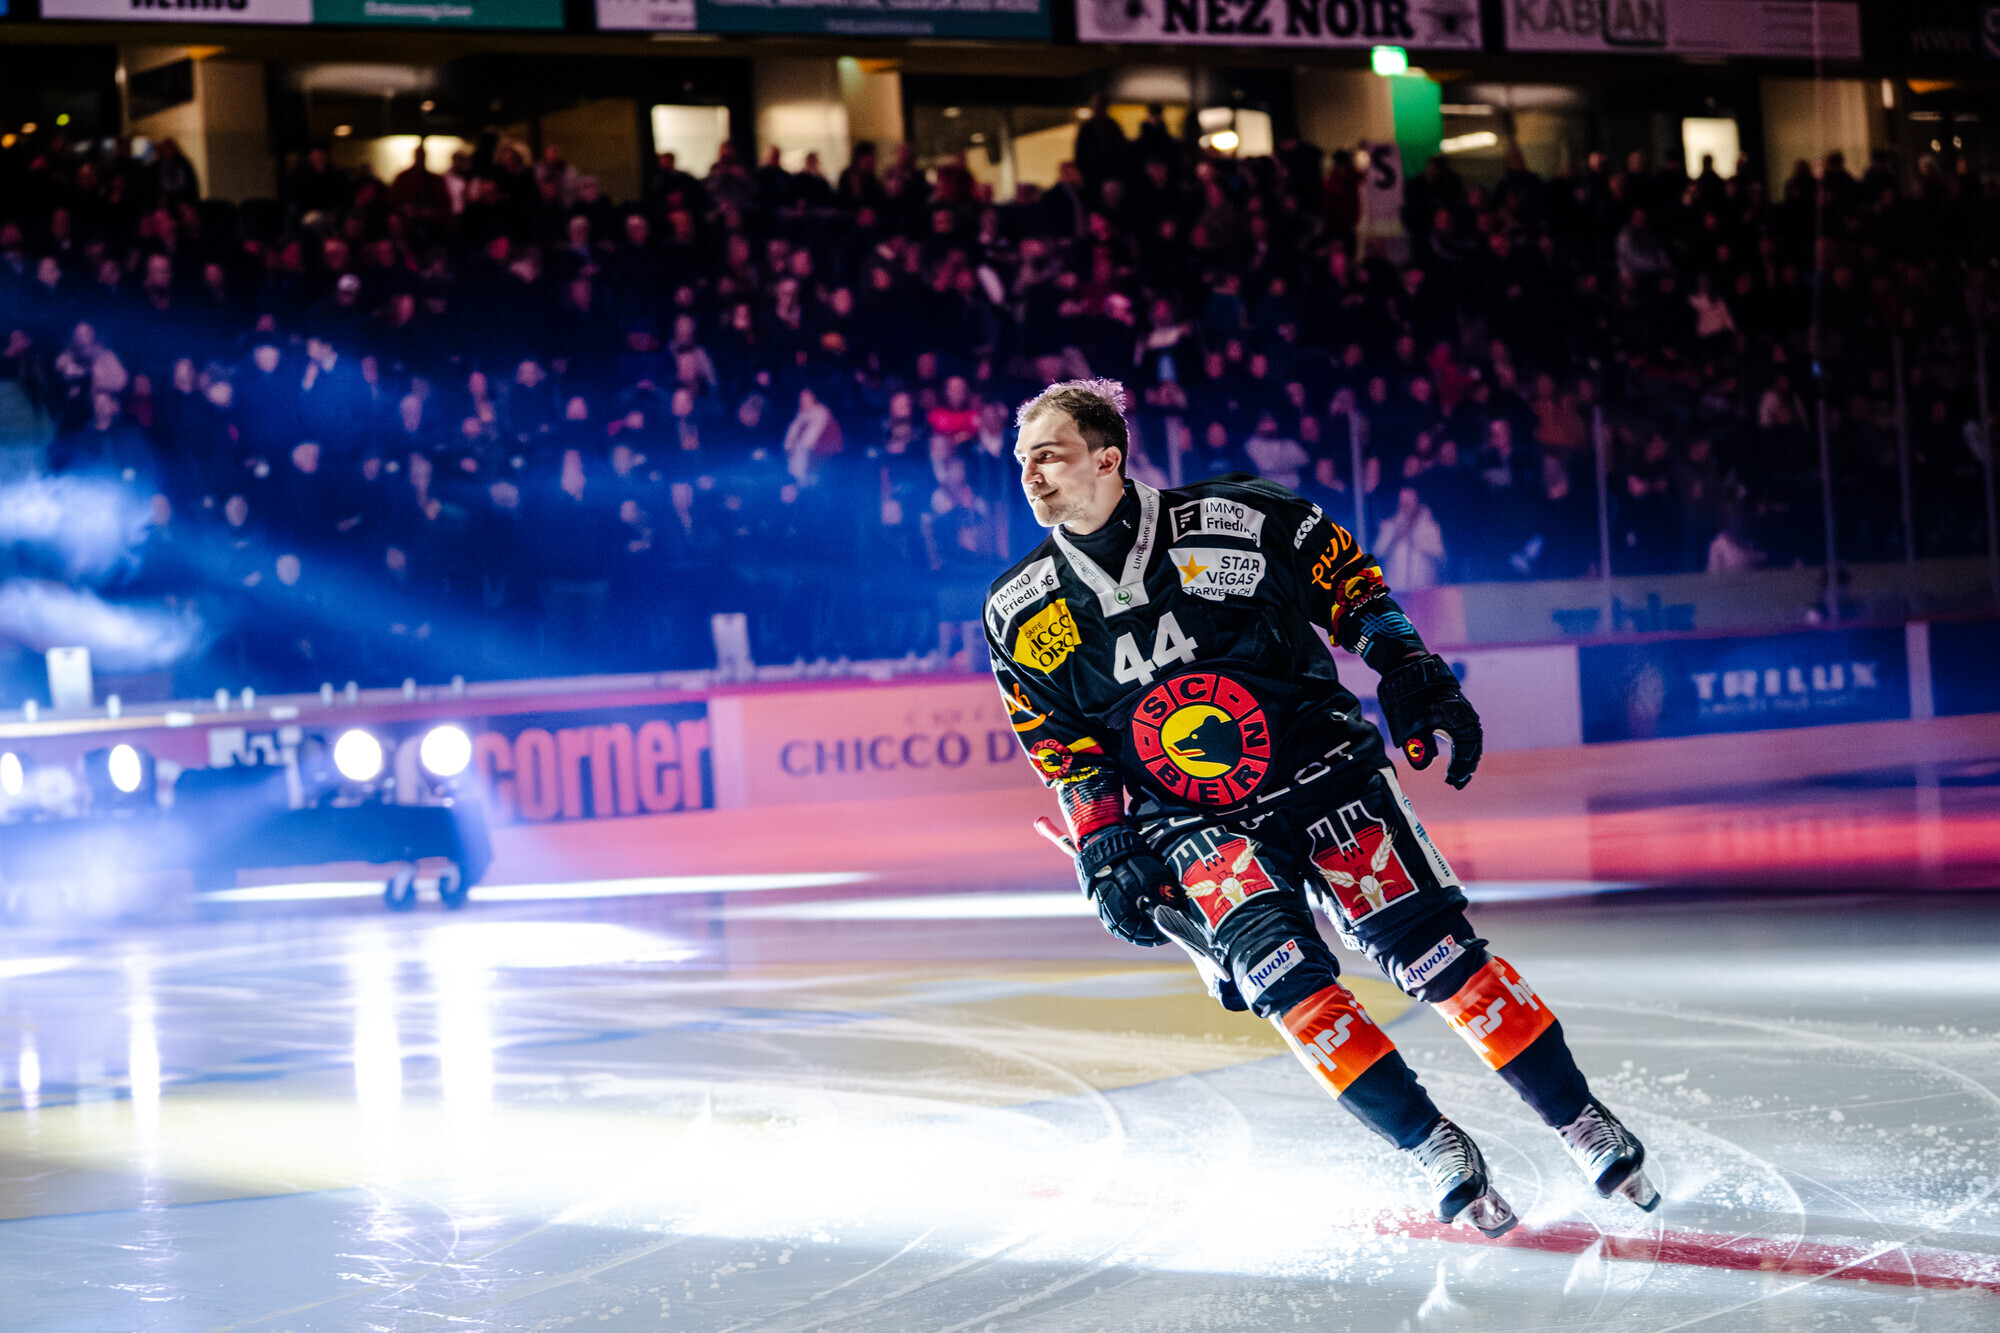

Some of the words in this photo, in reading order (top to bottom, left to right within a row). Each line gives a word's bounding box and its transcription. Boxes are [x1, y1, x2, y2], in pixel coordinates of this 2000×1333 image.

[1161, 0, 1275, 35] NEZ
[1285, 0, 1415, 39] NOIR
[1205, 501, 1244, 519] IMMO
[1206, 572, 1257, 586] VEGAS
[1220, 555, 1260, 573] STAR
[996, 573, 1031, 604] IMMO
[1002, 586, 1039, 616] Friedli
[1040, 575, 1055, 591] AG
[1113, 611, 1198, 686] 44
[1691, 661, 1878, 700] TRILUX
[475, 718, 710, 821] corner
[780, 730, 971, 776] CHICCO
[1250, 949, 1291, 990] hwob
